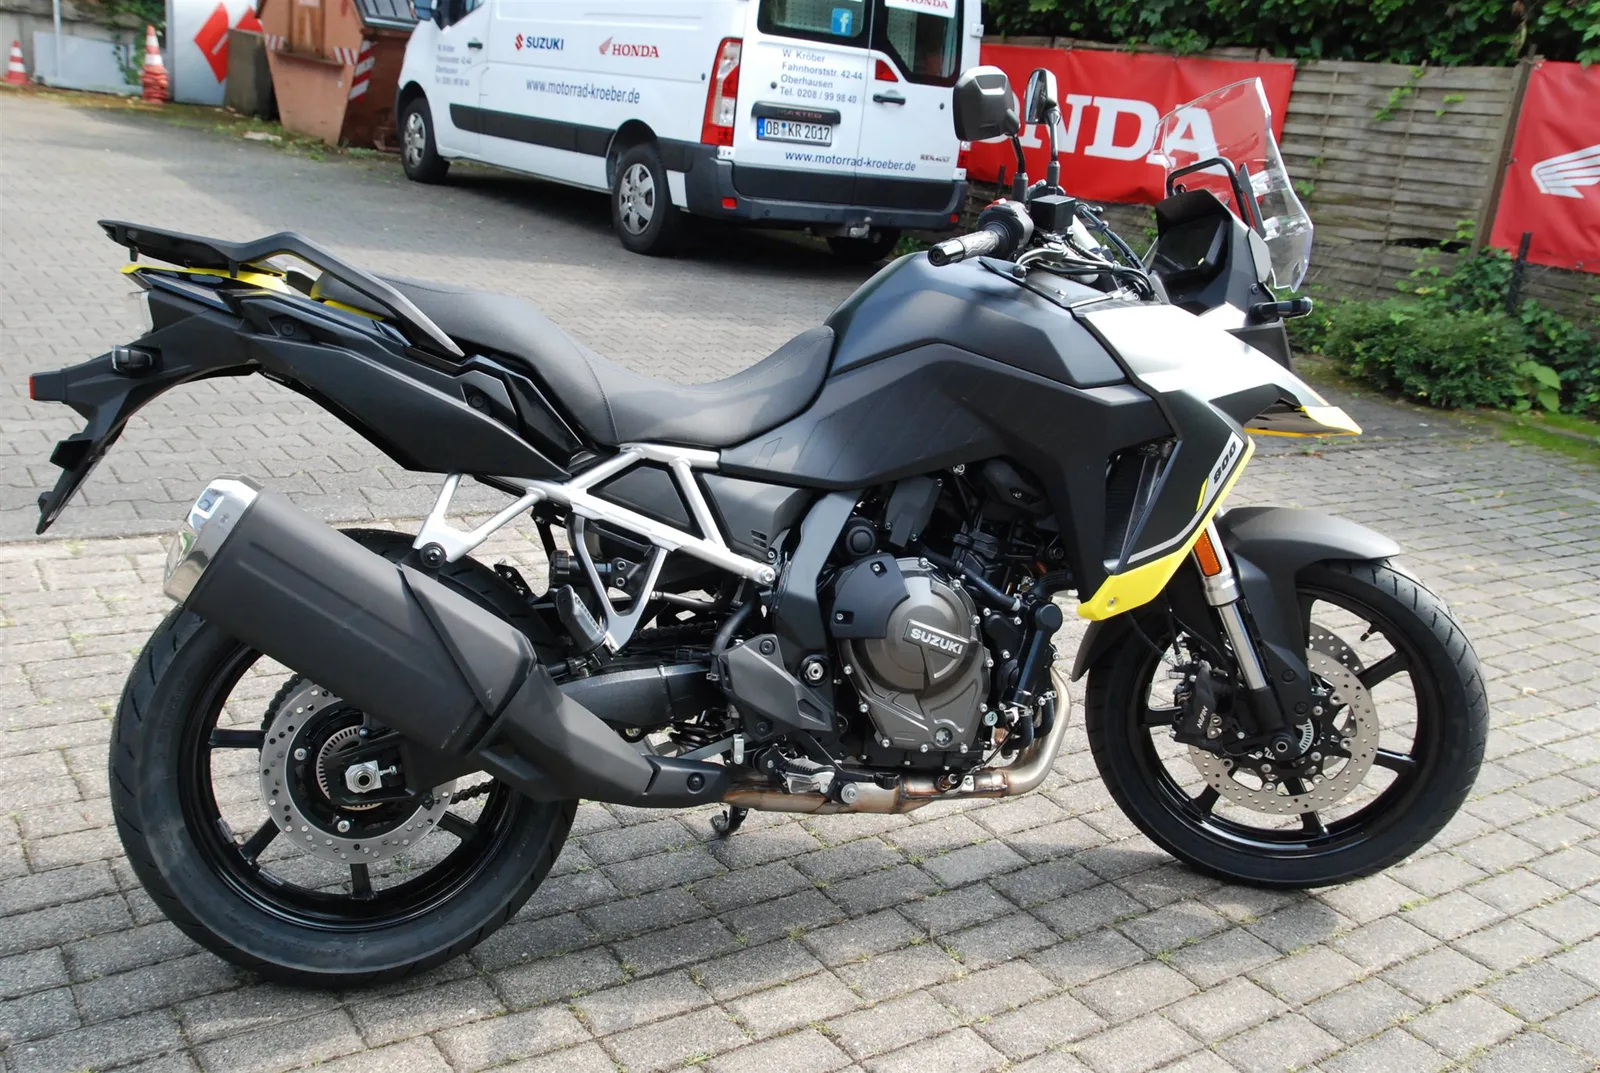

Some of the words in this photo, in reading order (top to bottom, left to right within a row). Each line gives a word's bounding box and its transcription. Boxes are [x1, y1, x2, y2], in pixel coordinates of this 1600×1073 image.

[526, 36, 564, 50] SUZUKI
[612, 44, 659, 58] HONDA
[796, 51, 826, 62] Kröber
[781, 74, 833, 88] Oberhausen
[841, 70, 863, 80] 42-44
[526, 79, 640, 104] www.motorrad-kroeber.de
[797, 89, 817, 99] 0208
[824, 92, 834, 101] 99
[836, 94, 846, 102] 98
[847, 95, 857, 104] 40
[765, 121, 779, 135] OB
[788, 123, 801, 137] KR
[804, 125, 830, 140] 2017
[785, 151, 916, 171] www.motorrad-kroeber.de
[1213, 441, 1236, 484] 800
[910, 628, 964, 655] SUZUKI
